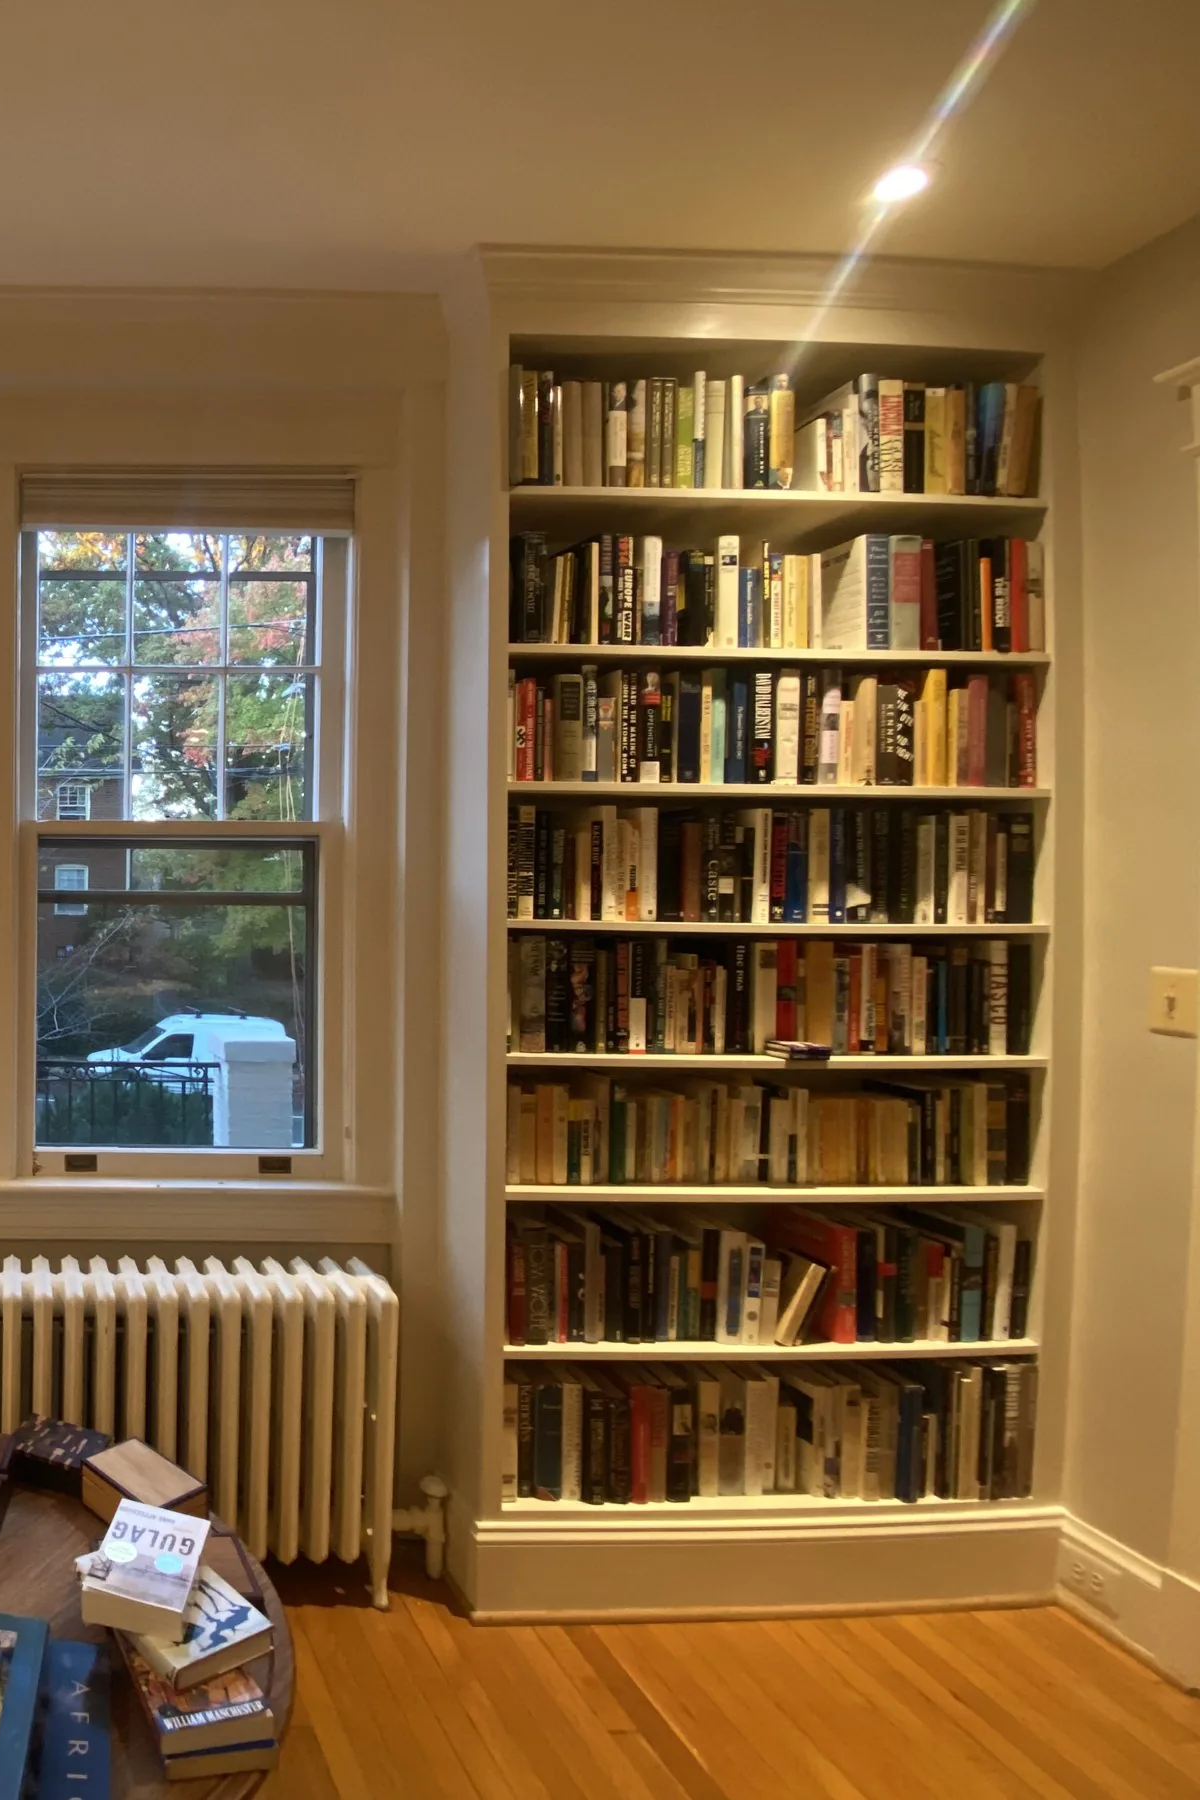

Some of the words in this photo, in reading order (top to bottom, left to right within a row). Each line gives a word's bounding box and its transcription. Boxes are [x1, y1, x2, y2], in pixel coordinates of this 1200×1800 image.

[880, 394, 905, 436] LINCOLN
[624, 568, 634, 609] EUROPE
[995, 576, 1005, 597] THE
[623, 612, 633, 640] WAR
[995, 598, 1005, 628] REICH
[754, 673, 773, 694] DAVID
[586, 695, 598, 727] SOLDIERS
[622, 706, 630, 719] THE
[753, 694, 773, 739] HALBERSTAM
[622, 721, 630, 751] ATOMIC
[629, 726, 637, 756] MAKING
[646, 708, 655, 758] OPPENHEIMER
[886, 703, 895, 753] KENNAN
[621, 752, 629, 775] BOMB
[629, 758, 636, 768] OF
[508, 870, 519, 902] TIME
[518, 873, 535, 897] WAR
[707, 859, 720, 901] Caste
[990, 962, 1008, 1025] FIASCO
[529, 1243, 548, 1280] TOM
[529, 1283, 548, 1331] WOLFE
[519, 1384, 534, 1442] Kennedys
[111, 1519, 196, 1557] GULAG
[162, 1710, 207, 1732] WILLIAM
[205, 1699, 265, 1723] MANCHESTER
